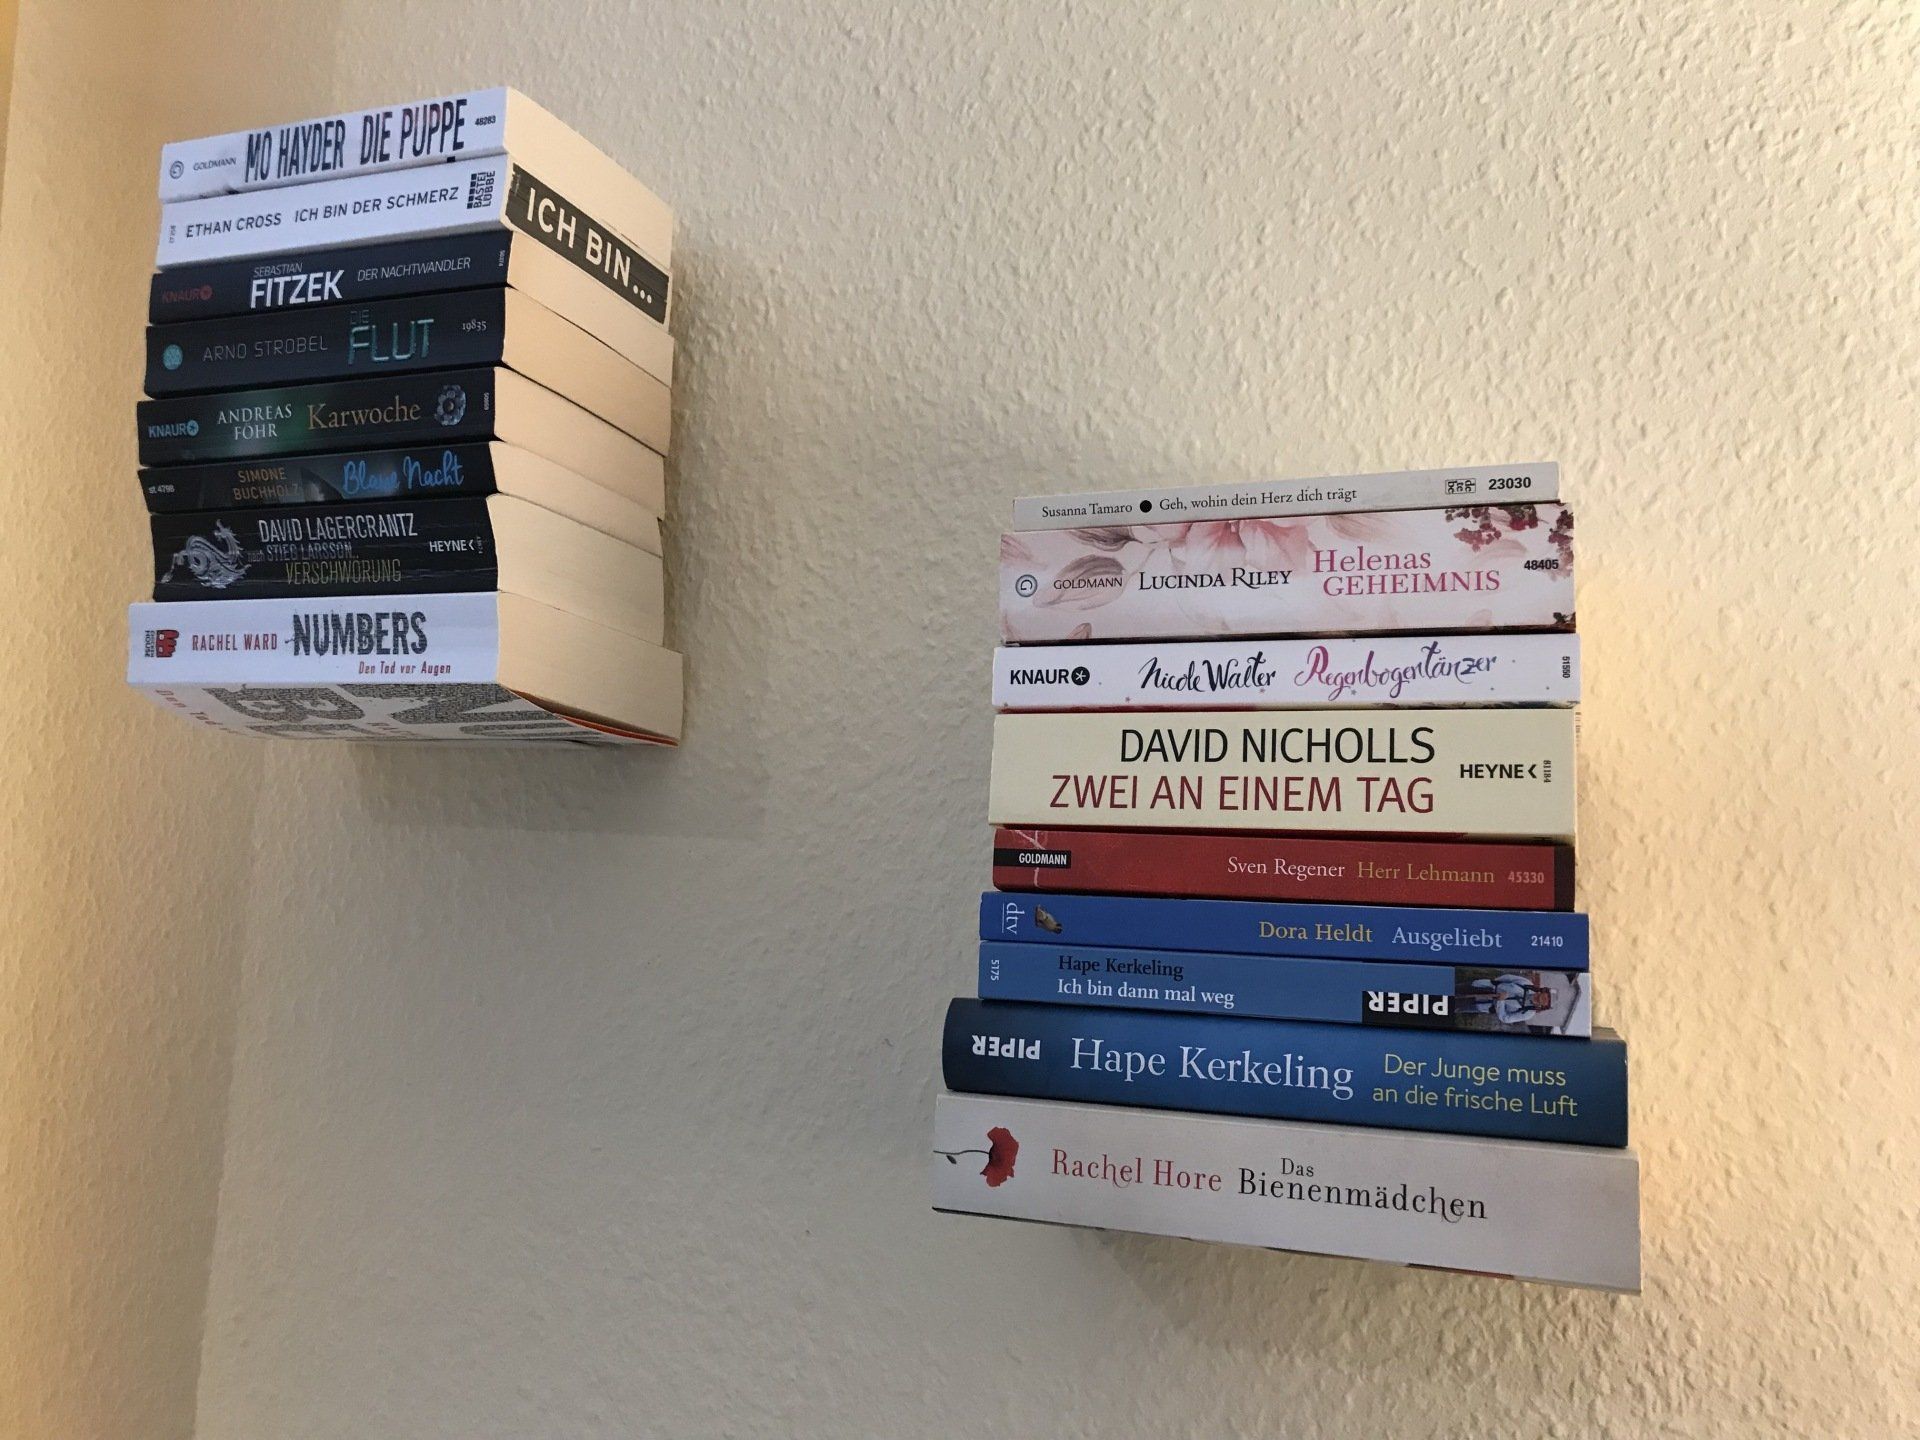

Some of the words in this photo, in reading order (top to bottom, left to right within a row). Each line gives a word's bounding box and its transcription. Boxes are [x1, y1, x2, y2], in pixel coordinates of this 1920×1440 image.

[360, 111, 393, 165] DIE
[399, 99, 467, 159] PUPPE
[475, 115, 496, 126] 48283
[245, 130, 272, 183] MO
[277, 118, 346, 179] HAYDER
[193, 157, 237, 171] GOLDMANN
[473, 171, 487, 209] BASTEI
[294, 207, 319, 223] ICH
[323, 203, 348, 219] BIN
[352, 199, 382, 214] DER
[386, 186, 459, 210] SCHMERZ
[186, 219, 232, 238] ETHAN
[236, 212, 282, 231] CROSS
[527, 187, 577, 249] ICH
[253, 263, 303, 277] SEBASTIAN
[357, 268, 378, 282] DER
[381, 257, 471, 279] NACHTWANDLER
[162, 288, 201, 304] KNAUR
[250, 269, 345, 309] FITZEK
[350, 309, 371, 325] DIE
[462, 319, 487, 333] 19835
[202, 343, 248, 363] ARNO
[255, 334, 329, 358] STROBEL
[347, 318, 435, 365] FLUT
[217, 403, 293, 425] ANDREAS
[307, 394, 422, 431] Karwoche
[148, 423, 187, 440] KNAUR
[237, 466, 287, 483] SIMONE
[342, 459, 400, 495] Blaue
[402, 450, 465, 490] Nacht
[1488, 476, 1532, 491] 23030
[233, 482, 302, 501] BUCHHOLZ
[1159, 498, 1188, 512] Geh,
[1191, 497, 1229, 509] wohin
[1232, 494, 1258, 507] dein
[1260, 491, 1293, 505] Herz
[1296, 488, 1324, 503] dich
[1327, 487, 1358, 505] trägt
[1041, 505, 1088, 519] Susanna
[1088, 502, 1133, 516] Tamaro
[258, 518, 302, 543] DAVID
[305, 511, 419, 542] LAGERCRANTZ
[266, 544, 299, 563] STIEG
[429, 539, 468, 553] HEYNE
[1312, 546, 1432, 573] Helenas
[1523, 559, 1559, 571] 48405
[1053, 576, 1123, 590] GOLDMANN
[1138, 571, 1226, 590] LUCINDA
[1231, 567, 1293, 590] RILEY
[1323, 570, 1501, 597] GEHEIMNIS
[192, 634, 238, 651] RACHEL
[244, 633, 278, 651] WARD
[292, 610, 428, 657] NUMBERS
[358, 660, 376, 675] Den
[380, 660, 396, 674] Tod
[399, 664, 417, 674] vor
[420, 660, 452, 677] Augen
[1010, 669, 1069, 685] KNAUR
[1137, 656, 1205, 693] Nicole
[1202, 651, 1277, 692] Walter
[1294, 640, 1498, 701] Regenbogentänzer
[1562, 655, 1571, 679] 51550
[1120, 728, 1229, 763] DAVID
[1242, 726, 1436, 764] NICHOLLS
[1459, 763, 1525, 779] HEYNE
[1543, 759, 1552, 783] 81184
[1049, 774, 1139, 809] ZWEI
[1149, 775, 1204, 810] AN
[1218, 775, 1343, 813] EINEM
[1356, 776, 1435, 814] TAG
[1018, 852, 1068, 866] GOLDMANN
[1227, 856, 1268, 875] Sven
[1273, 858, 1346, 882] Regener
[1357, 861, 1401, 879] Herr
[1407, 863, 1496, 884] Lehmann
[1507, 870, 1546, 885] 45330
[1006, 902, 1026, 935] dtv
[1259, 921, 1309, 940] Dora
[1314, 923, 1374, 943] Heldt
[1391, 926, 1503, 952] Ausgeliebt
[1530, 935, 1564, 948] 21410
[990, 959, 1000, 981] 5175
[1058, 955, 1101, 976] Hape
[1106, 957, 1185, 981] Kerkeling
[1057, 978, 1083, 996] Ich
[1087, 978, 1114, 996] bin
[1117, 980, 1160, 999] dann
[1164, 985, 1197, 1003] mal
[1200, 990, 1236, 1009] weg
[1367, 990, 1449, 1016] PIPER
[972, 1034, 1042, 1060] PIPER
[1070, 1036, 1167, 1083] Hape
[1178, 1044, 1354, 1101] Kerkeling
[1384, 1053, 1428, 1075] Der
[1430, 1057, 1502, 1087] Junge
[1507, 1066, 1567, 1087] muss
[1372, 1087, 1398, 1104] an
[1404, 1085, 1439, 1107] die
[1444, 1086, 1525, 1113] frische
[1530, 1094, 1579, 1118] Luft
[1050, 1148, 1143, 1189] Rachel
[1152, 1158, 1224, 1193] Hore
[1280, 1157, 1315, 1178] Das
[1237, 1167, 1488, 1224] Bienenmädchen
